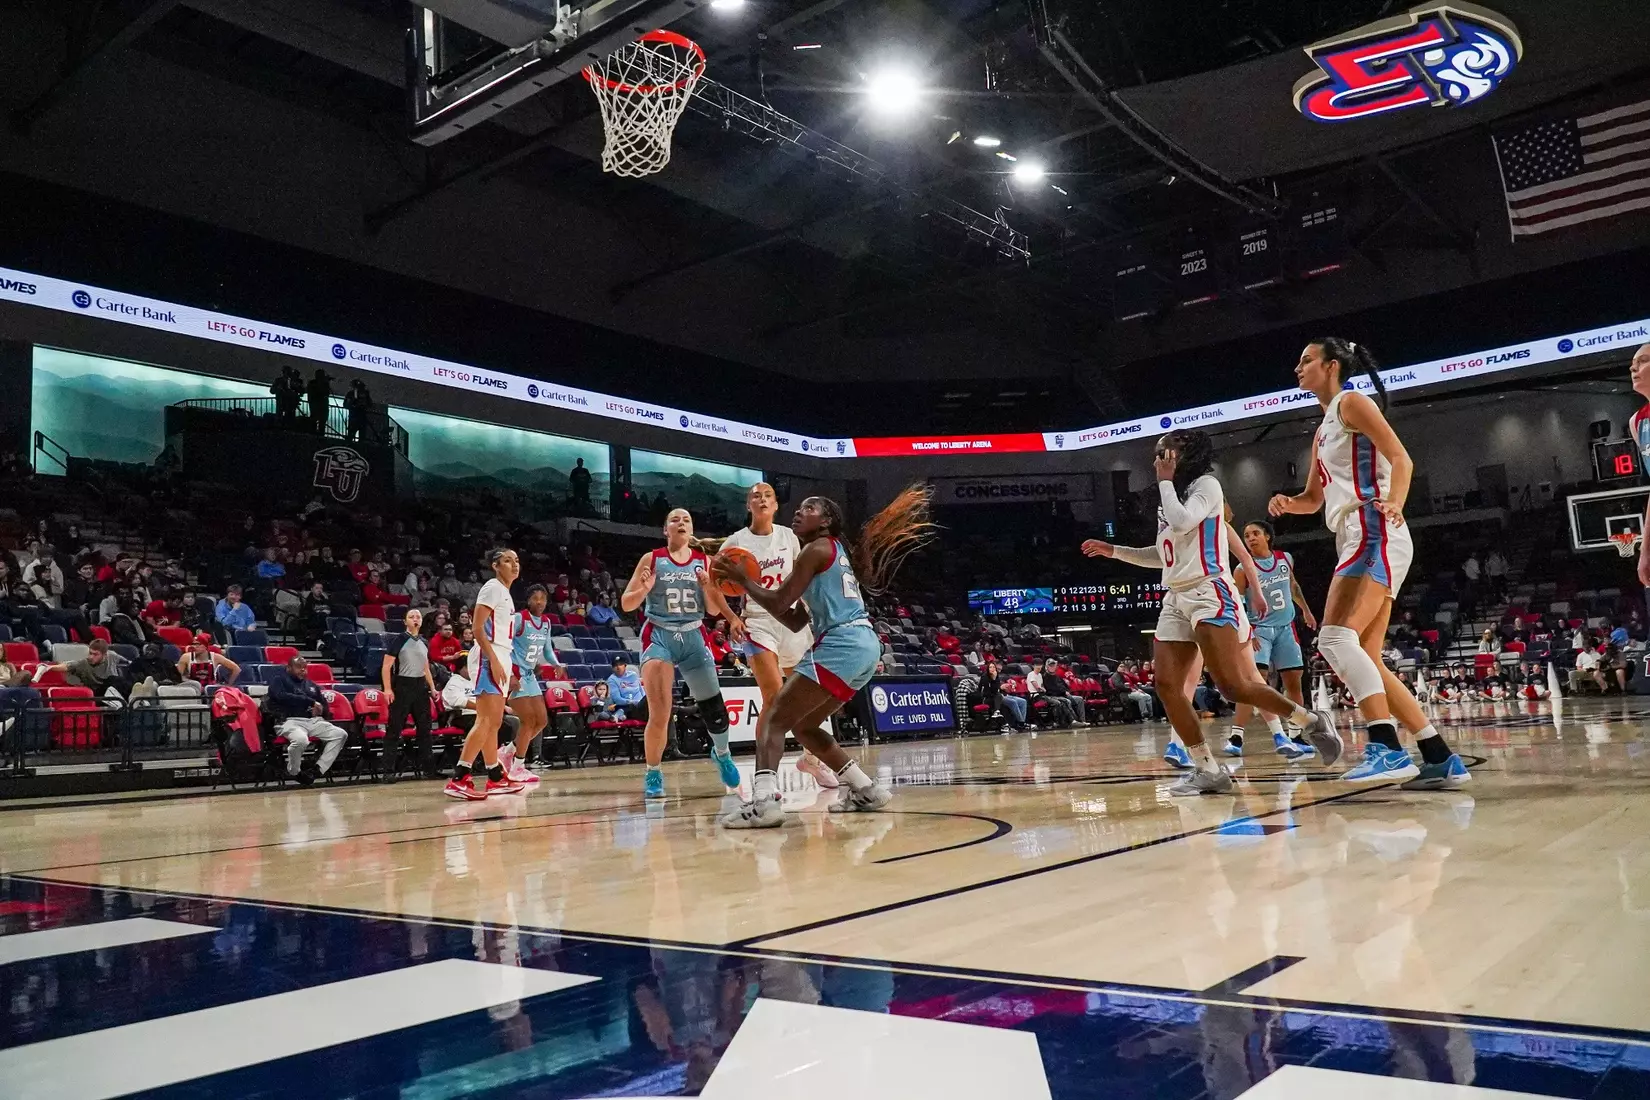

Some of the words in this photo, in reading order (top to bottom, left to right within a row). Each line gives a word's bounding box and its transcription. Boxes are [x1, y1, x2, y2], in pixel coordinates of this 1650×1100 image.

[1243, 239, 1267, 256] 2019
[1181, 258, 1207, 276] 2023
[96, 298, 139, 316] Carter
[142, 306, 176, 324] Bank
[208, 320, 237, 335] LET'S
[239, 328, 255, 339] GO
[259, 331, 306, 349] FLAMES
[1577, 334, 1613, 348] Carter
[1616, 326, 1648, 340] Bank
[350, 349, 382, 365] Carter
[384, 356, 410, 371] Bank
[1441, 361, 1466, 373] LET'S
[1468, 358, 1483, 368] GO
[1486, 349, 1530, 365] FLAMES
[433, 367, 456, 379] LET'S
[457, 372, 470, 382] GO
[472, 375, 508, 389] FLAMES
[1390, 371, 1416, 384] Bank
[541, 388, 566, 402] Carter
[568, 394, 588, 406] Bank
[1244, 396, 1265, 410] LET'S
[1266, 397, 1278, 406] GO
[606, 402, 624, 412] LET'S
[624, 406, 634, 415] GO
[636, 408, 664, 421] FLAMES
[1174, 413, 1199, 425] Carter
[1201, 409, 1224, 420] Bank
[690, 419, 711, 431] Carter
[712, 423, 728, 434] Bank
[1079, 432, 1097, 442] LET'S
[1097, 431, 1108, 439] GO
[1110, 424, 1141, 437] FLAMES
[757, 432, 766, 441] GO
[766, 435, 789, 446] FLAMES
[1615, 455, 1633, 474] 18
[955, 483, 1068, 498] CONCESSIONS
[1163, 539, 1174, 568] 0
[994, 589, 1028, 597] LIBERTY
[1110, 585, 1131, 594] 6:41
[666, 588, 698, 613] 25
[1004, 598, 1018, 608] 48
[1270, 589, 1285, 610] 3
[890, 691, 924, 707] Carter
[925, 689, 950, 706] Bank
[892, 715, 904, 725] LIFE
[909, 714, 926, 724] LIVED
[930, 712, 946, 722] FULL
